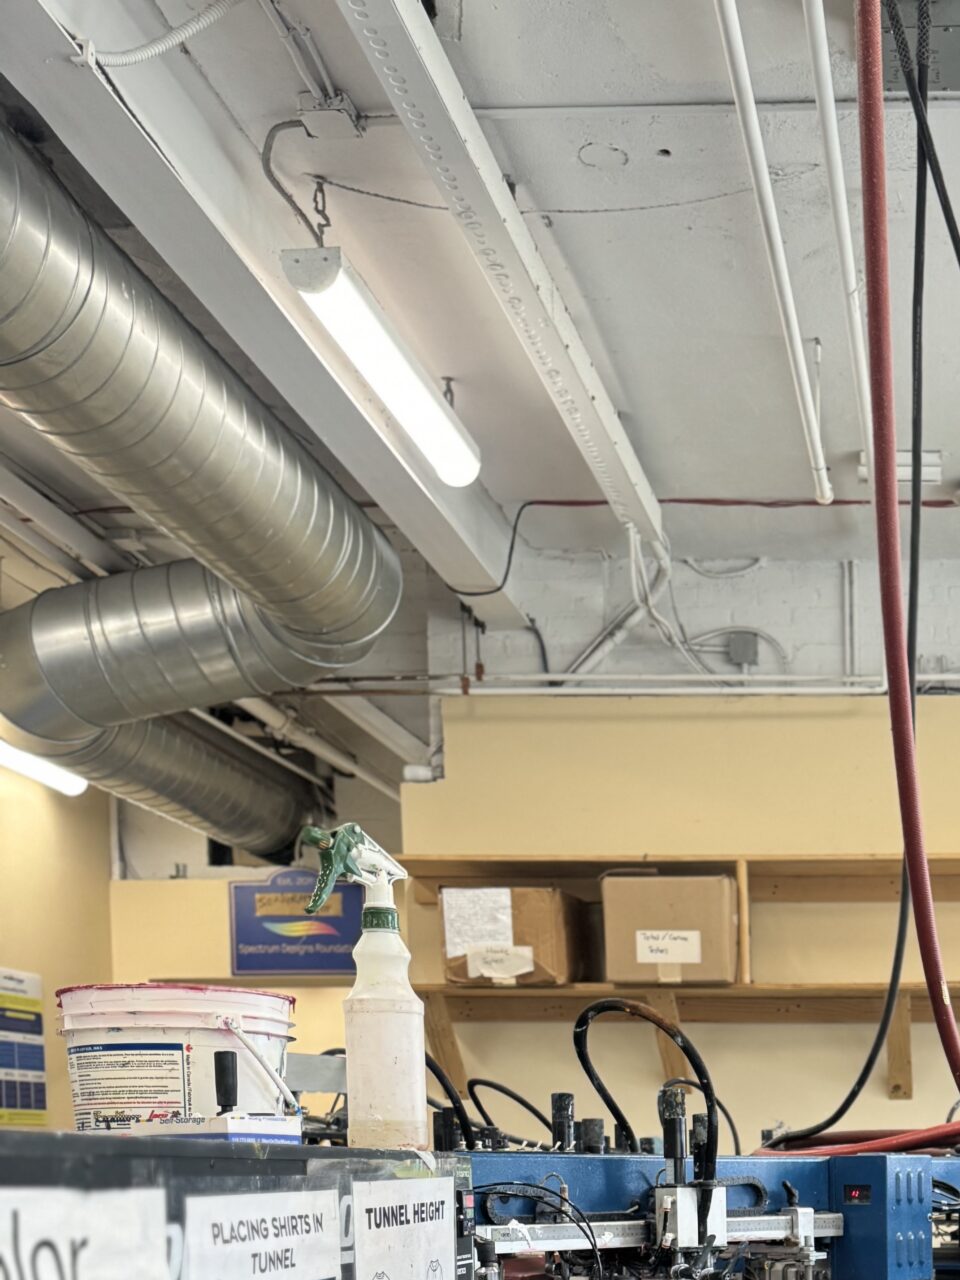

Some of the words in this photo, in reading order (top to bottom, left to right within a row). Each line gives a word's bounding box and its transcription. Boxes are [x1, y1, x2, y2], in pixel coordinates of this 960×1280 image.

[239, 943, 280, 955] Spectrum
[281, 943, 314, 955] Designs
[211, 1219, 269, 1245] PLACING
[271, 1214, 311, 1238] SHIRTS
[313, 1212, 323, 1233] IN
[365, 1204, 410, 1230] TUNNEL
[413, 1200, 445, 1223] HEIGHT
[251, 1248, 296, 1274] TUNNEL
